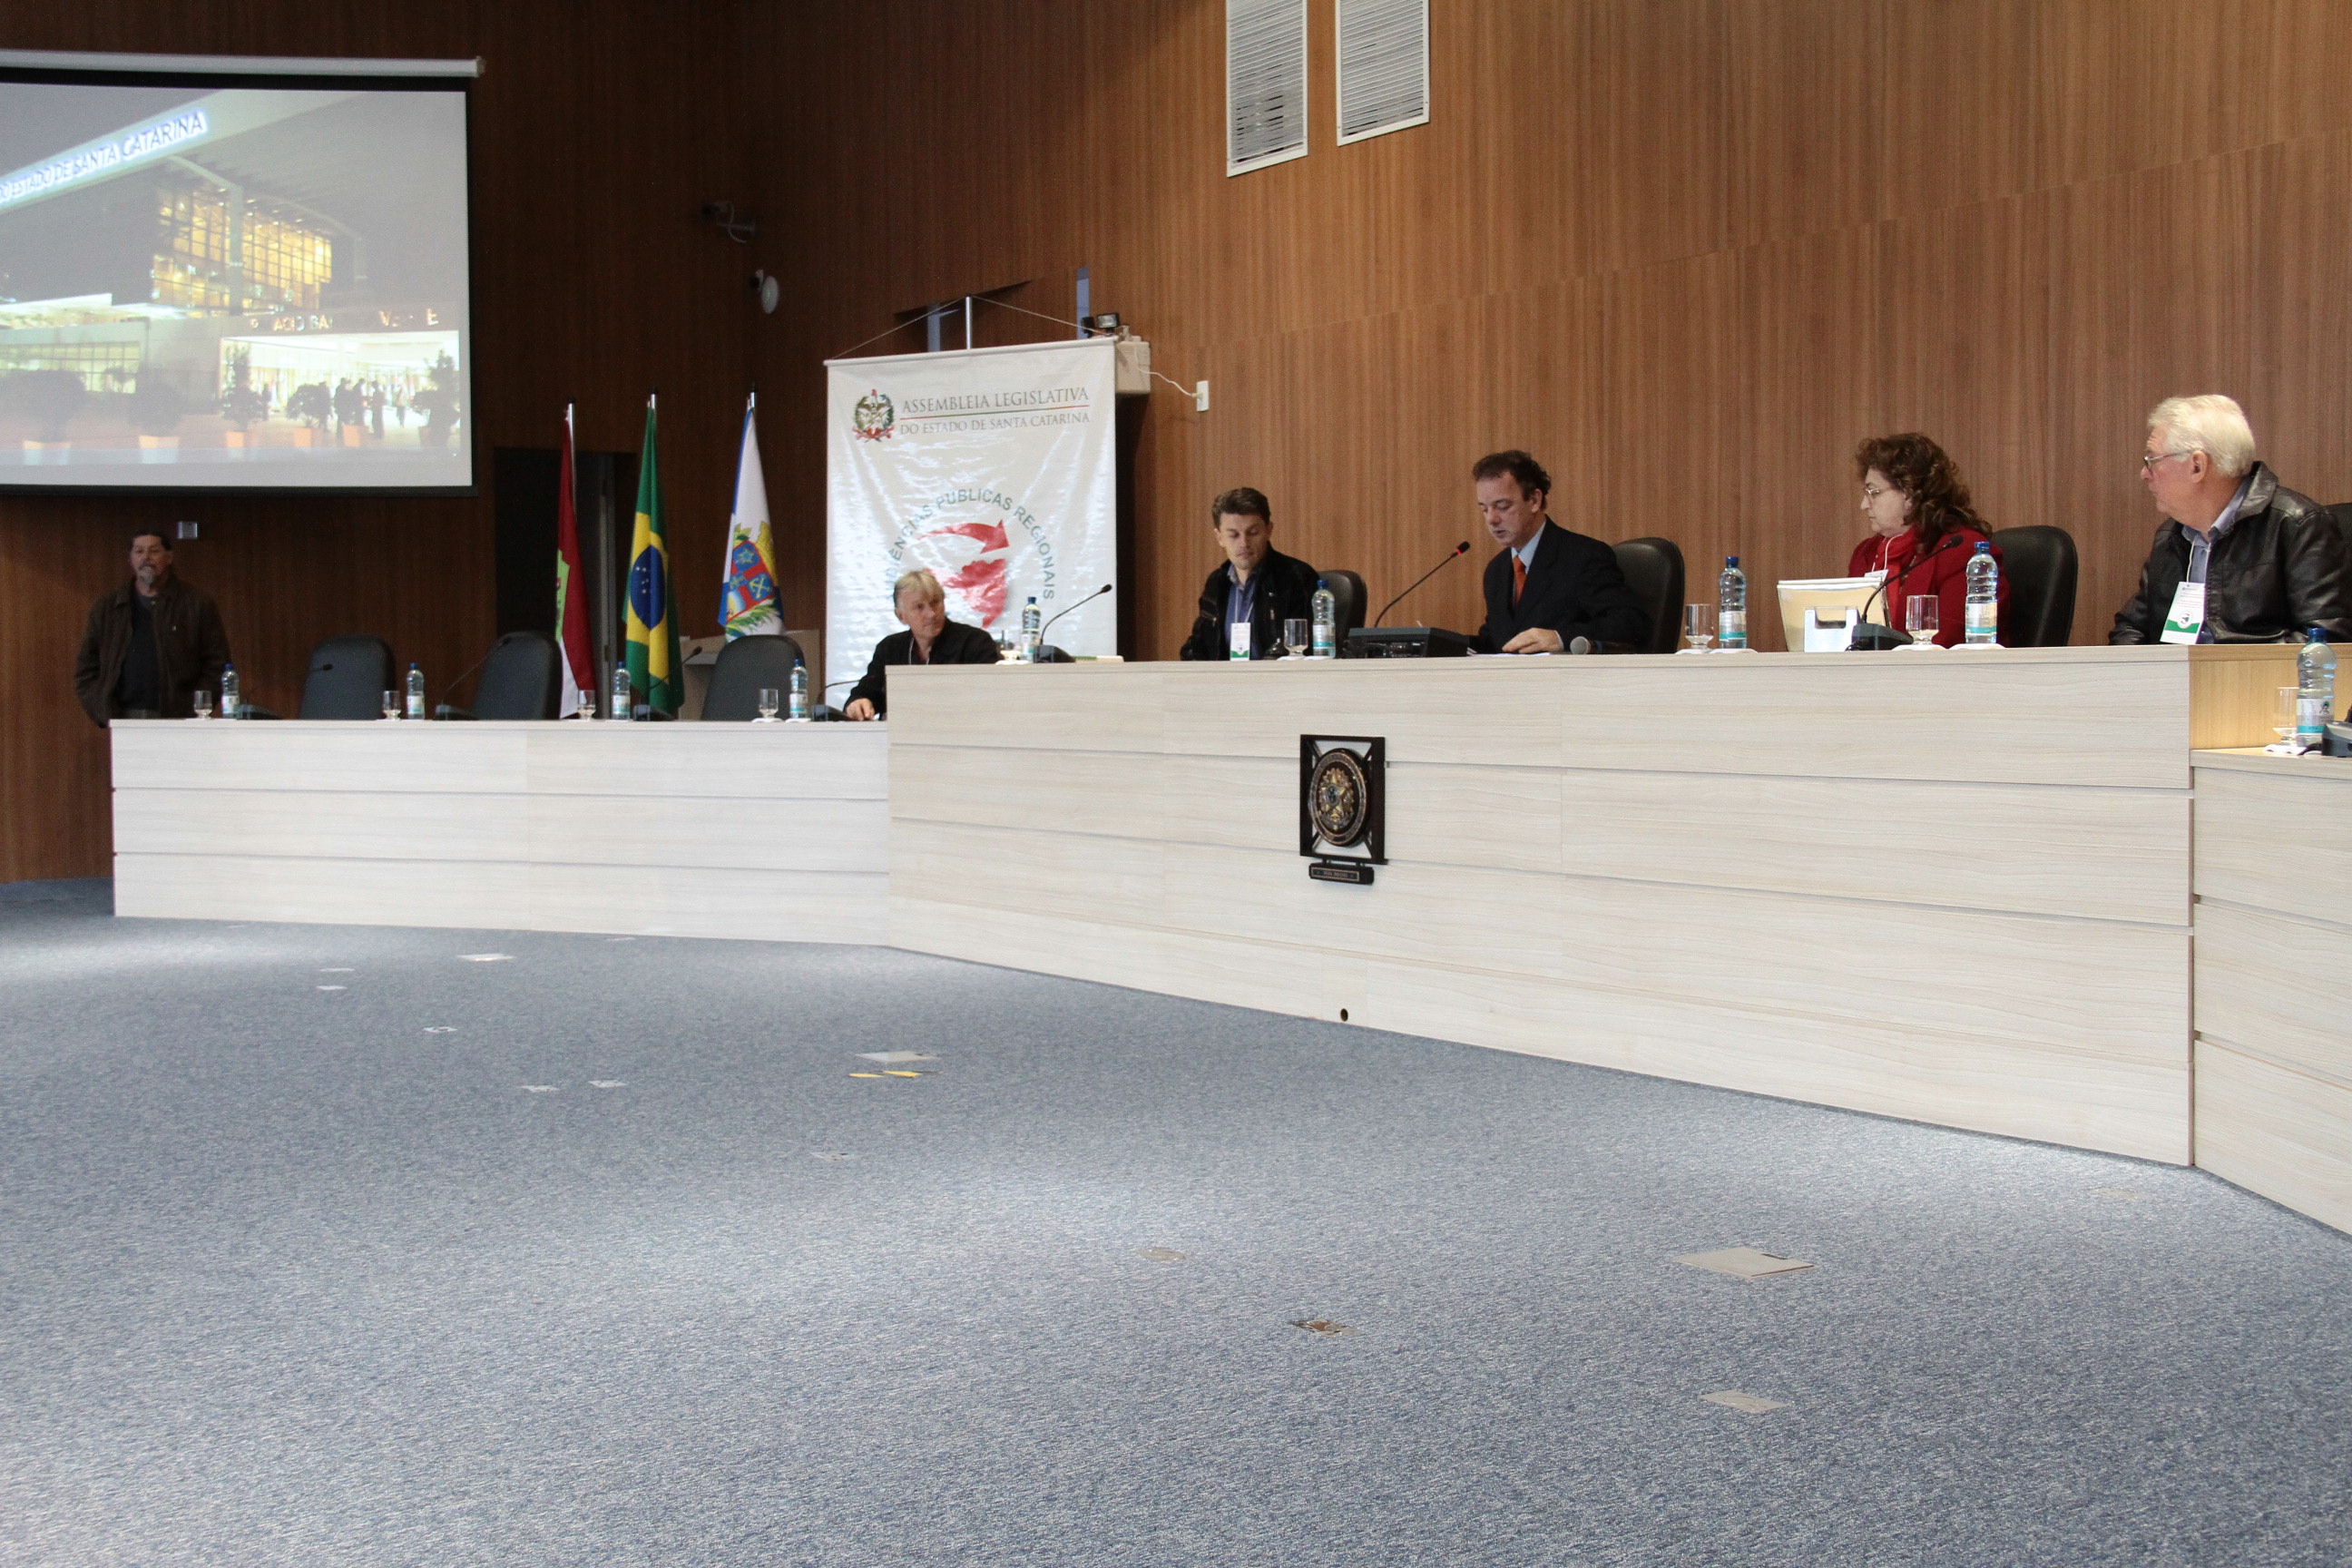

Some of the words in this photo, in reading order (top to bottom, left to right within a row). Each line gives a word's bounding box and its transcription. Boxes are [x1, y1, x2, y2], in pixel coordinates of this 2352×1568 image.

[54, 160, 73, 180] DE
[74, 144, 119, 175] SANTA
[122, 112, 204, 157] CATARINA
[900, 424, 919, 435] DO
[923, 420, 968, 434] ESTADO
[971, 419, 986, 431] DE
[990, 416, 1027, 430] SANTA
[1030, 412, 1090, 426] CATARINA
[902, 394, 990, 414] ASSEMBLEIA
[995, 387, 1089, 407] LEGISLATIVA
[1014, 505, 1056, 600] REGIONAIS
